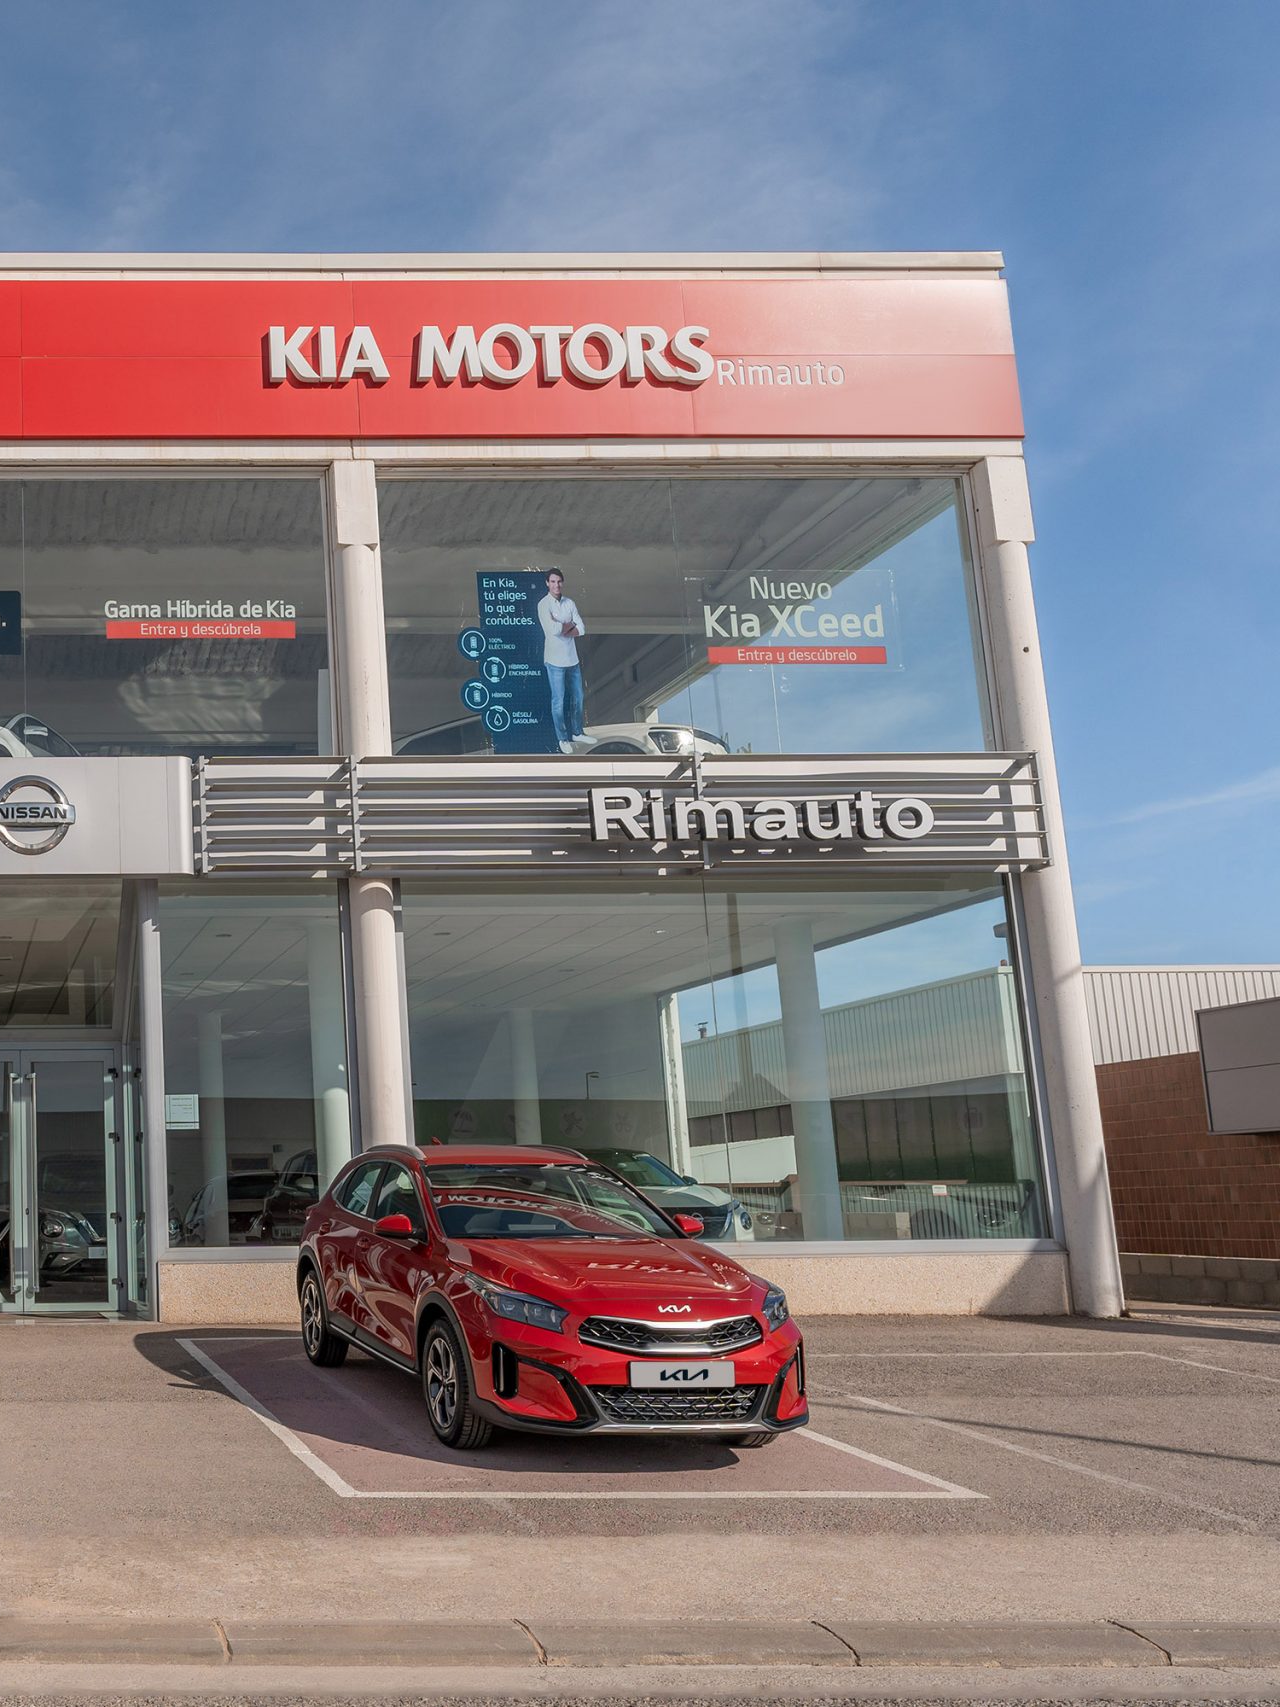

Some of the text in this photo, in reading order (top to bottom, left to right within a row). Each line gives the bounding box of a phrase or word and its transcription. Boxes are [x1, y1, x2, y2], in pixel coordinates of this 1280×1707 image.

[265, 322, 846, 388] KIA MOTORS Rimauto
[483, 577, 517, 589] En Kia,
[750, 576, 832, 600] Nuevo
[484, 590, 527, 603] tú eliges
[104, 599, 296, 619] Gama Híbrida de Kia
[484, 603, 516, 615] lo que
[485, 616, 536, 626] conduces.
[704, 604, 885, 638] Kia XCeed
[140, 622, 262, 639] Entra y descúbrela
[737, 647, 858, 664] Entra y descúbrelo
[588, 786, 936, 843] Rimauto
[659, 1368, 709, 1382] KIA
